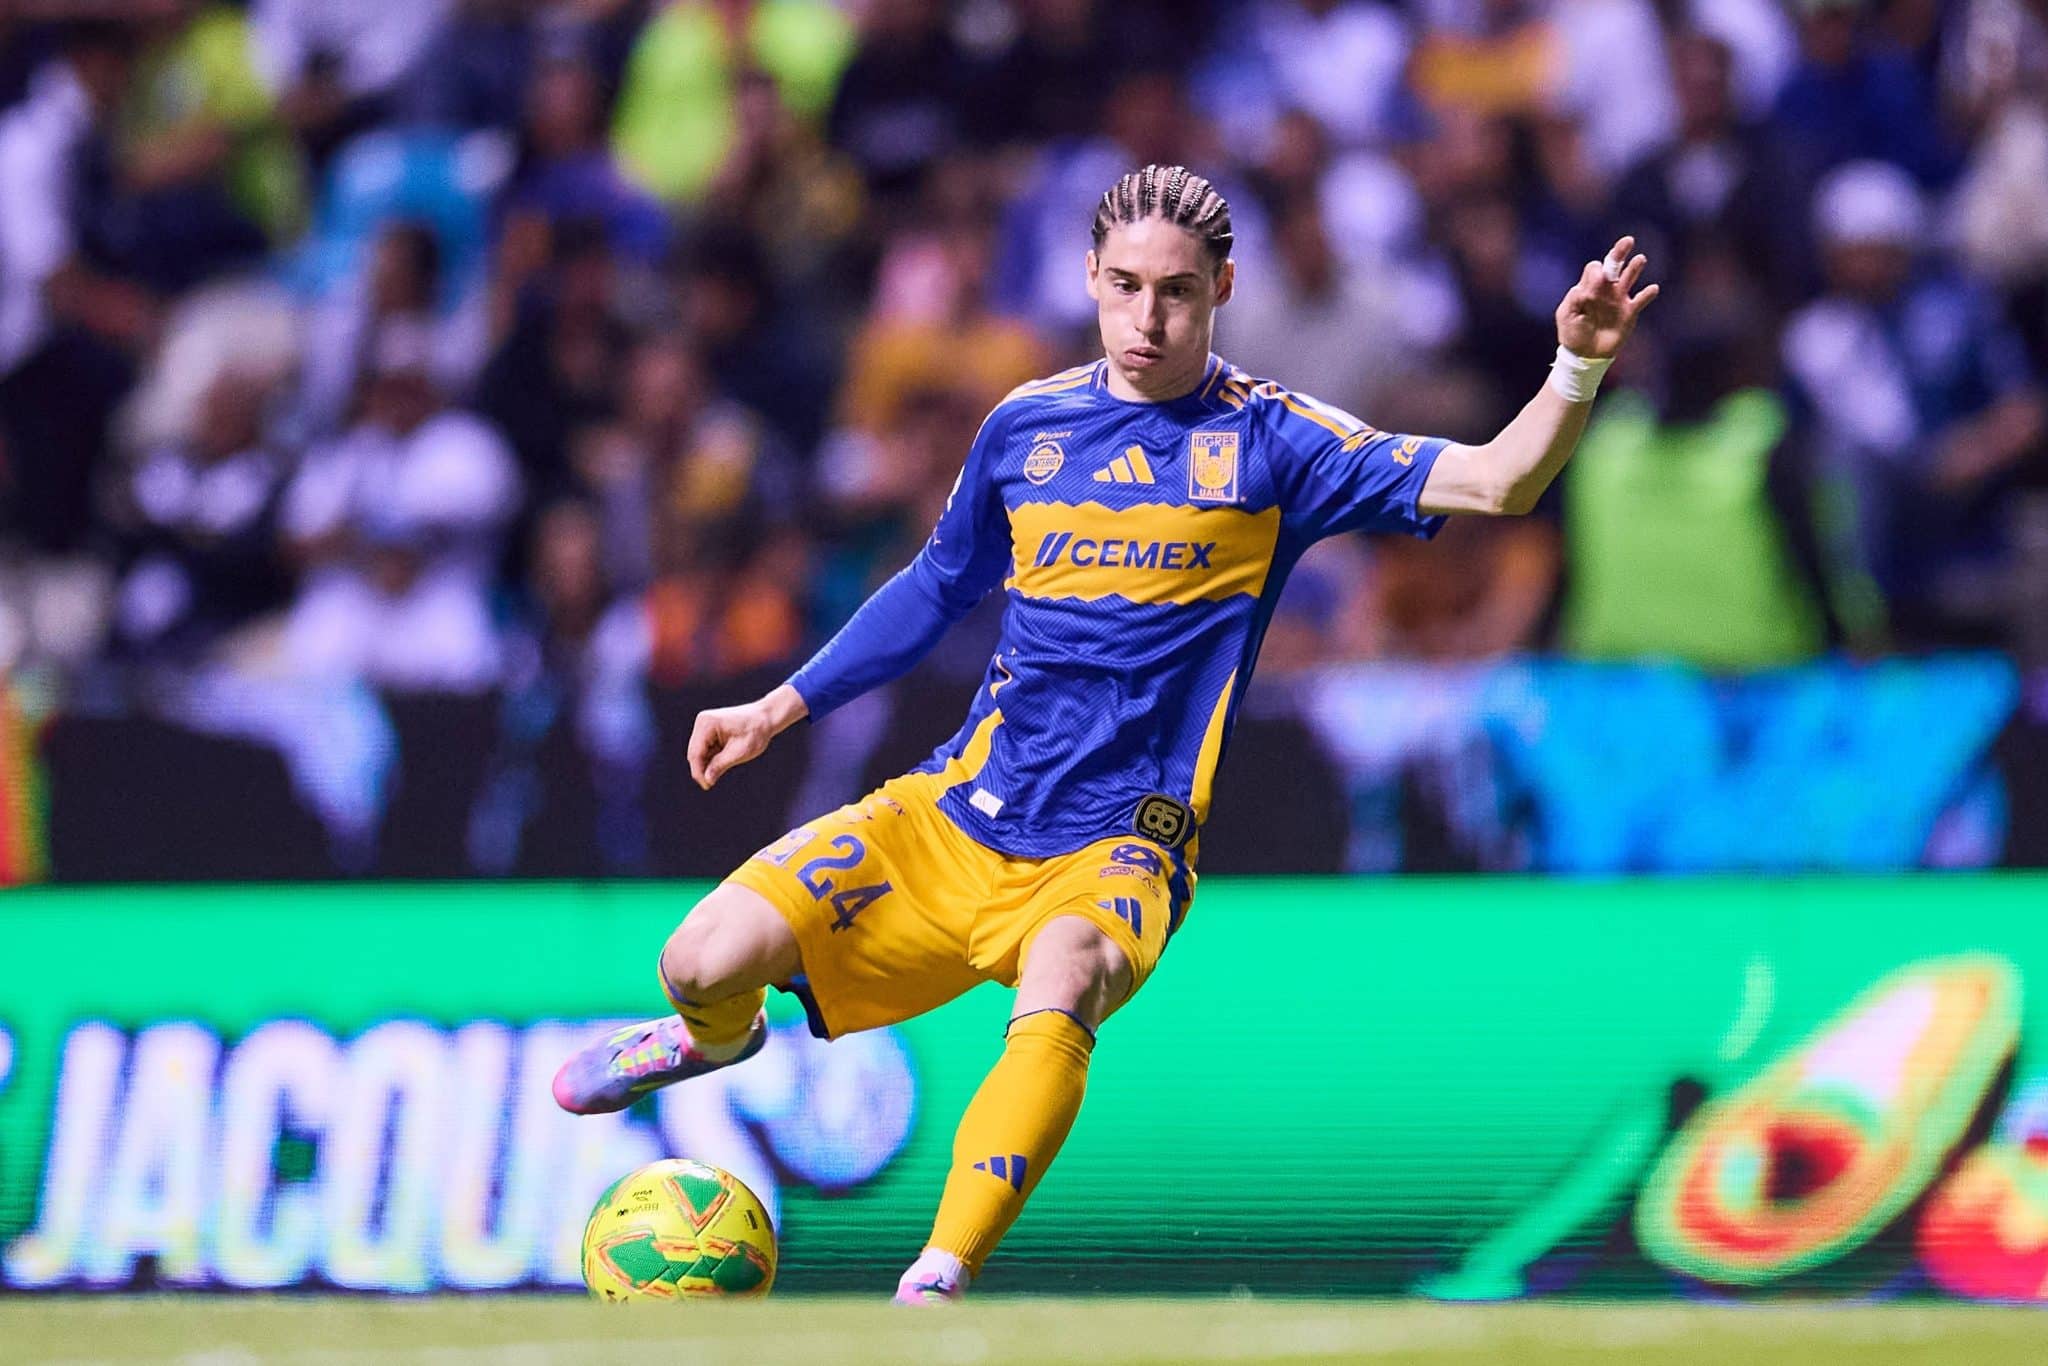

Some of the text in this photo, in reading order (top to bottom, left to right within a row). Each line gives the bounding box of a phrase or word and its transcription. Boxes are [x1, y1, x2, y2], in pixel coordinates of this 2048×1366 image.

[1194, 434, 1235, 448] TIGRES
[1199, 487, 1226, 498] UANL
[1070, 538, 1217, 570] CEMEX
[1142, 800, 1183, 836] 65
[796, 834, 893, 934] 24
